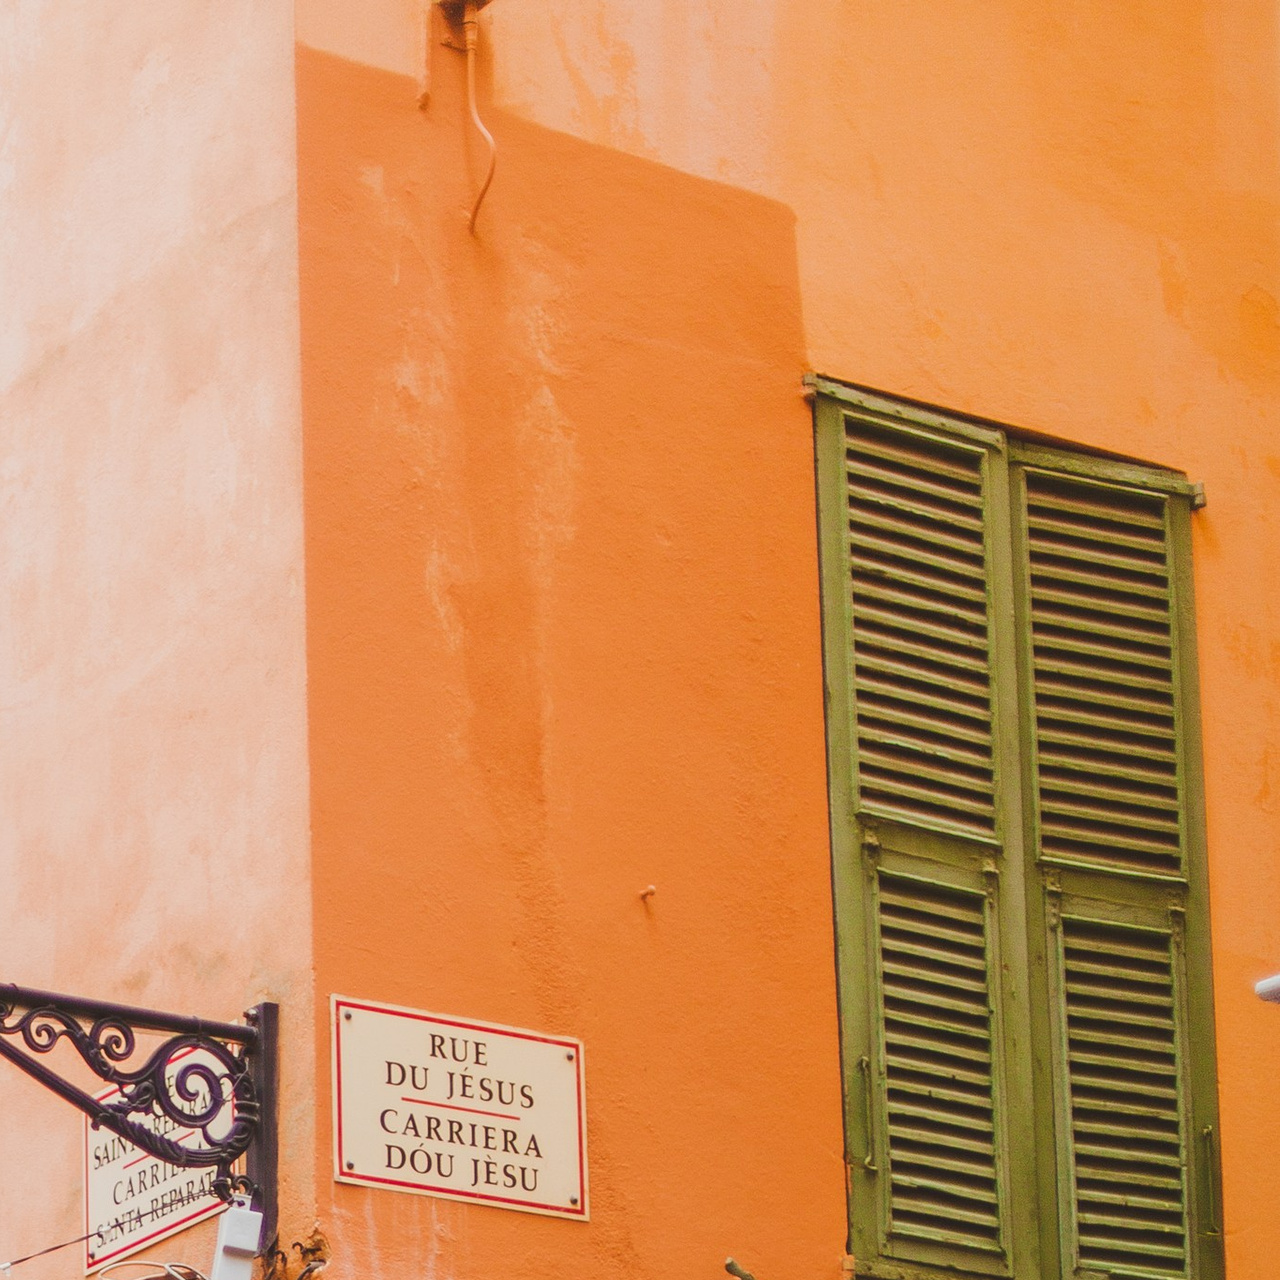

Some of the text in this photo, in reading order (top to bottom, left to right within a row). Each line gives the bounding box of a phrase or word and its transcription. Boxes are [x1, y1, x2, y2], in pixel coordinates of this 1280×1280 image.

[429, 1033, 488, 1067] RUE
[385, 1060, 535, 1109] DU JÉSUS
[379, 1108, 544, 1159] CARRIERA
[385, 1142, 539, 1192] DÓU JÈSU
[151, 1169, 216, 1223] REPARAT
